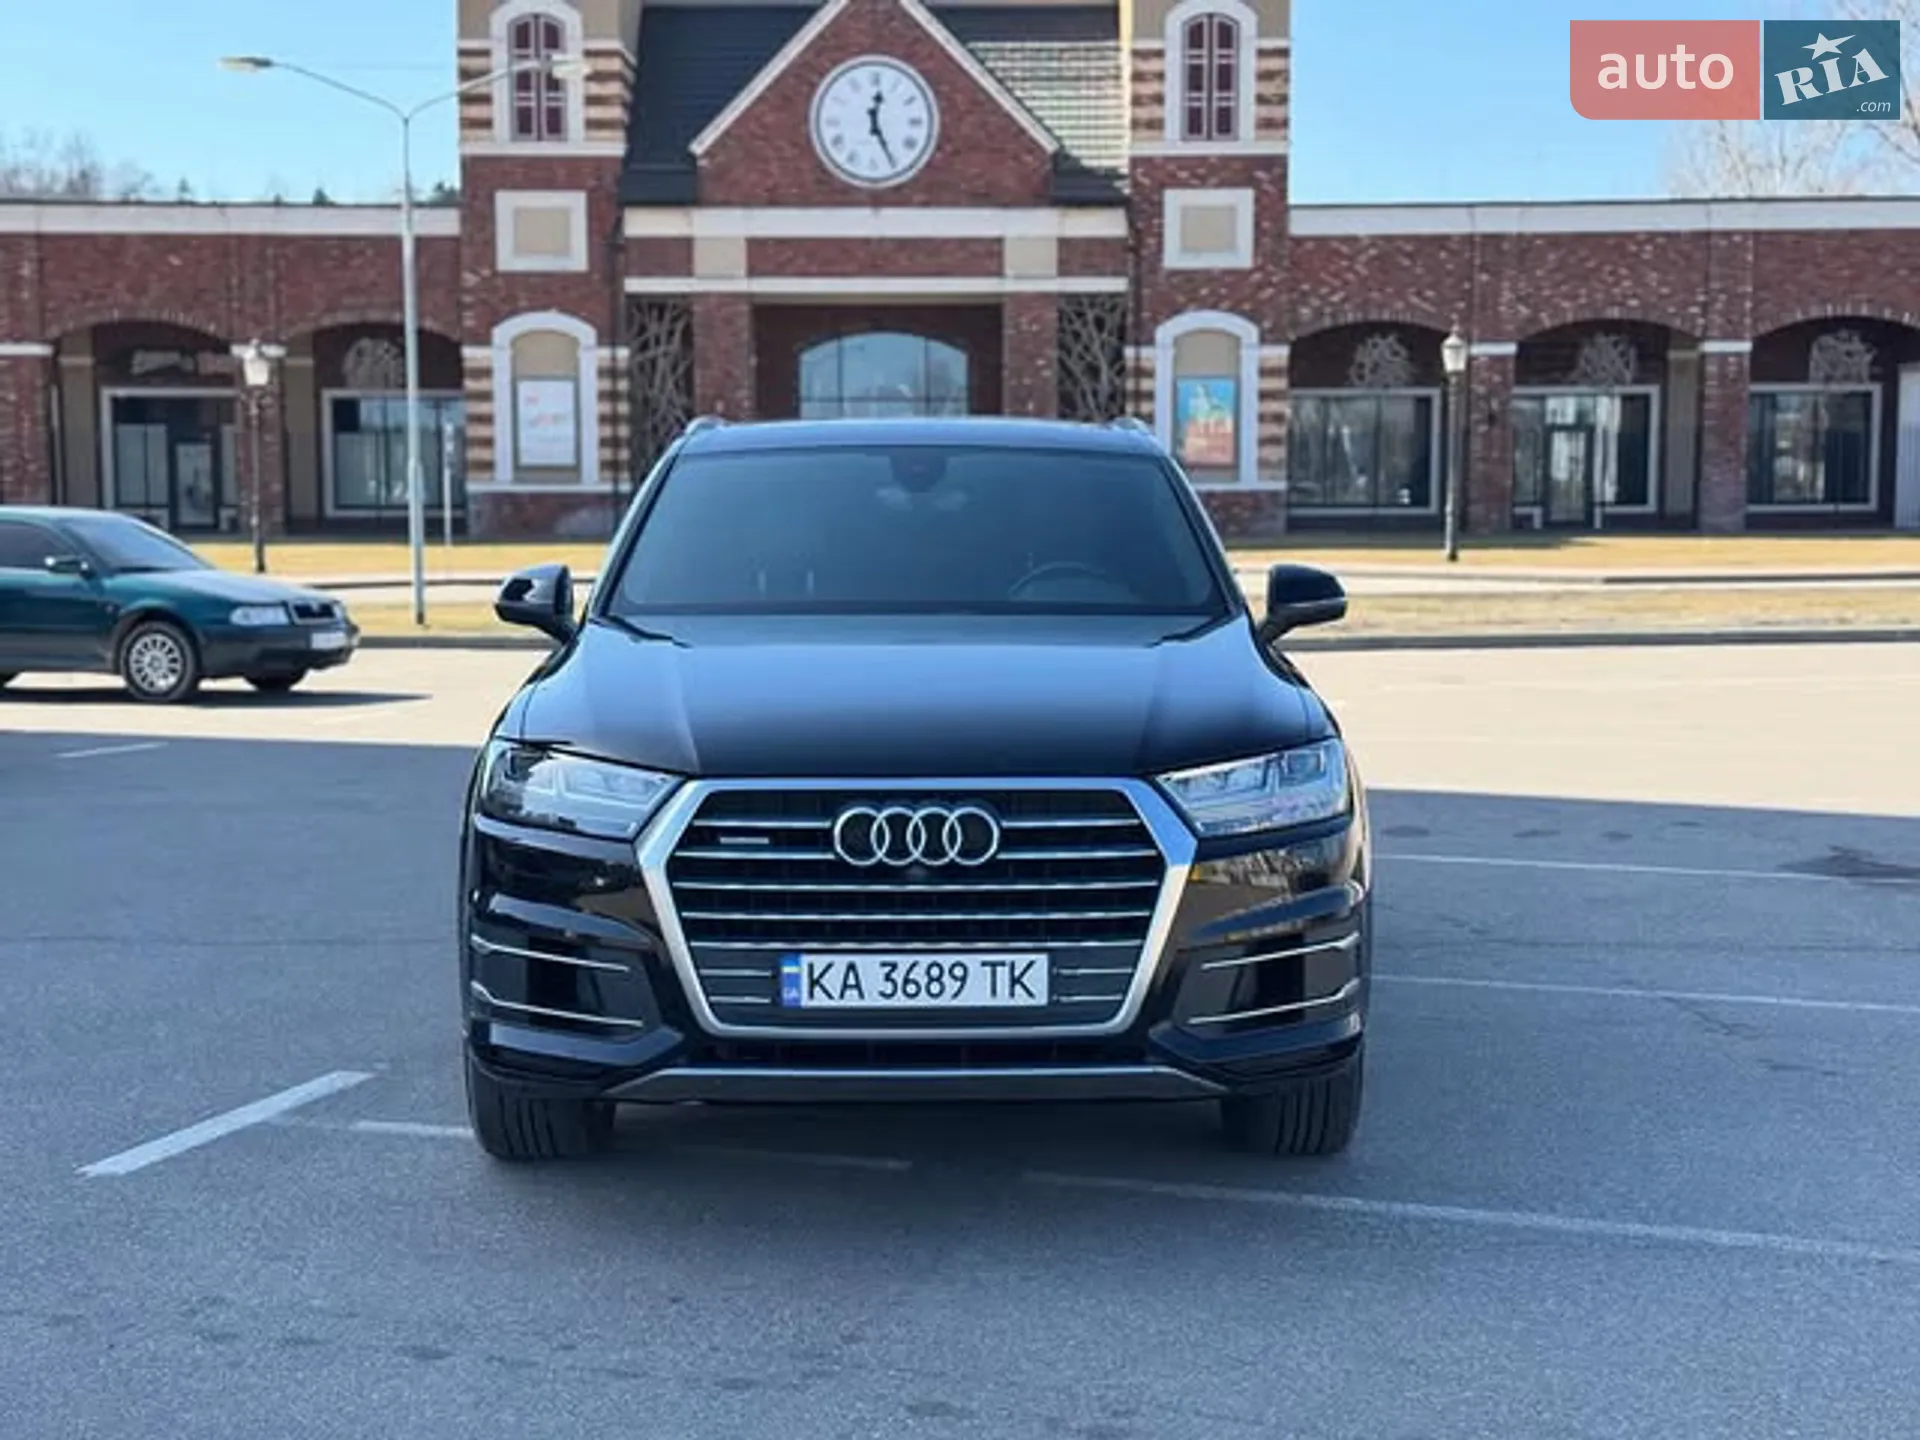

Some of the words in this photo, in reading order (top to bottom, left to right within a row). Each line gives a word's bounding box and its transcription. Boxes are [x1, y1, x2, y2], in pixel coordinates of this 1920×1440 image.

[807, 961, 865, 1000] KA
[878, 960, 968, 999] 3689
[981, 960, 1036, 998] TK
